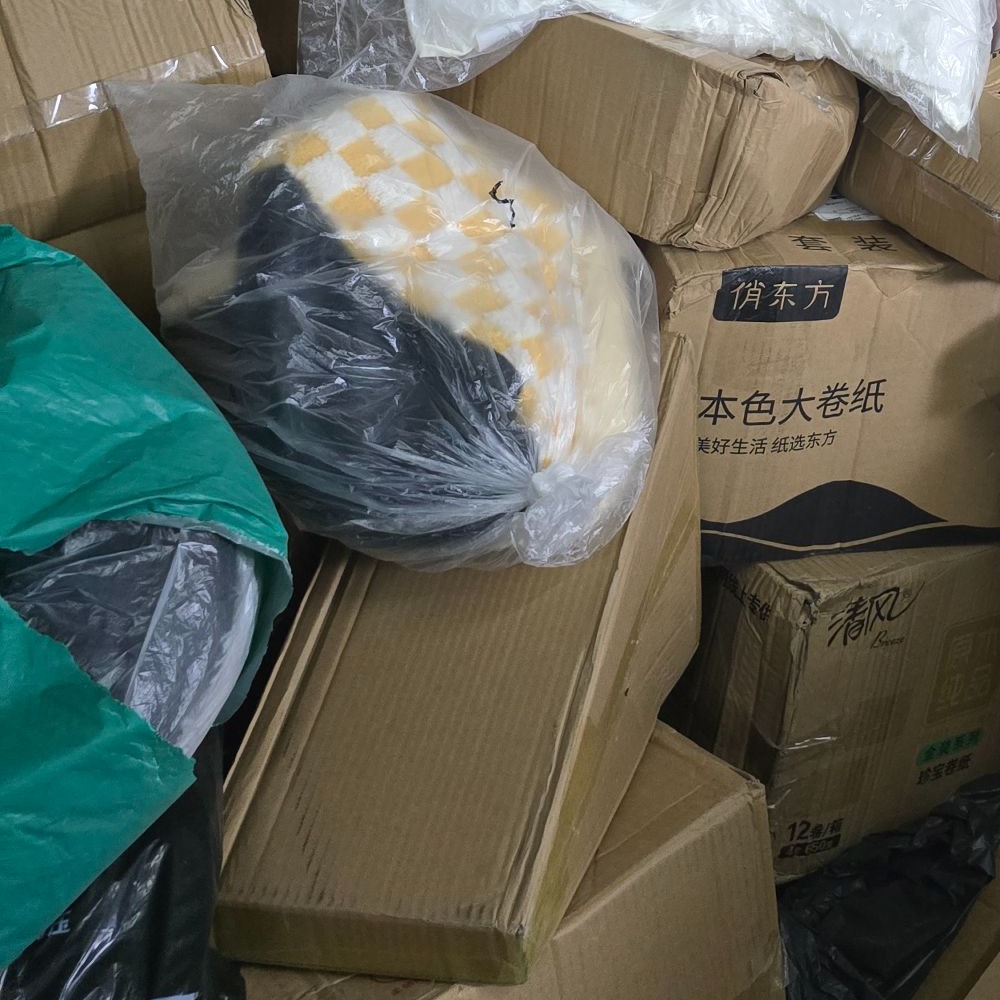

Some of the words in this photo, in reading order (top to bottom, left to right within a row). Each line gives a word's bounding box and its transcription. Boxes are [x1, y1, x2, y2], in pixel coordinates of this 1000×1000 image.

[788, 234, 898, 253] 套装
[730, 278, 835, 311] 俏东方
[697, 377, 889, 427] 本色大卷纸
[697, 435, 768, 456] 美好生活
[770, 428, 838, 454] 纸选东方
[827, 581, 926, 648] 清风
